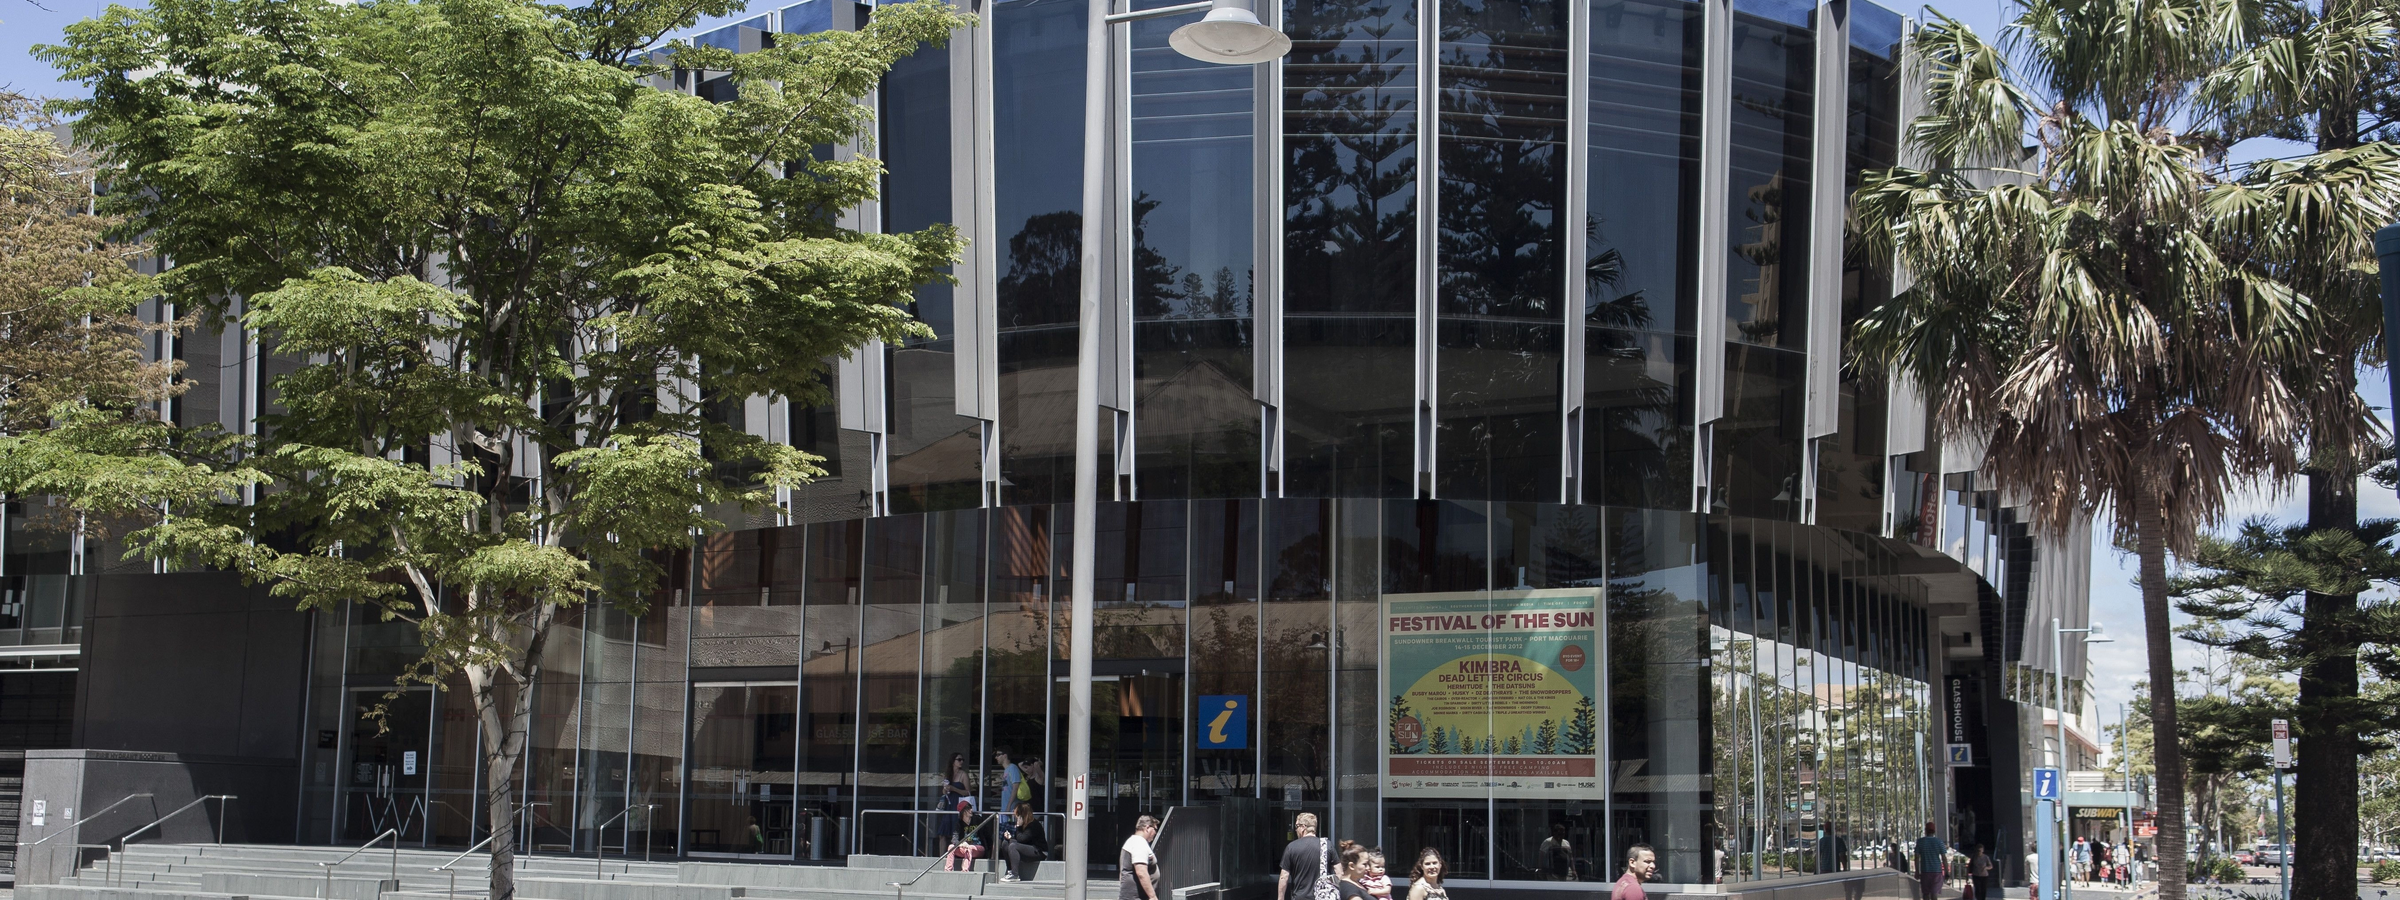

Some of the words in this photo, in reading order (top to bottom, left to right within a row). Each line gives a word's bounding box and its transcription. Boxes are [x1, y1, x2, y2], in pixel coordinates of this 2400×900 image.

[1390, 615, 1477, 632] FESTIVAL
[1481, 614, 1506, 629] OF
[1511, 613, 1549, 629] THE
[1554, 612, 1594, 628] SUN
[1459, 660, 1522, 673] KIMBRA
[1439, 674, 1465, 682] DEAD
[1467, 674, 1504, 682] LETTER
[1507, 673, 1543, 682] CIRCUS
[1953, 679, 1963, 742] GLASSHOUSE
[888, 729, 908, 738] BAR
[1075, 802, 1083, 816] P
[2076, 808, 2123, 818] SUBWAY
